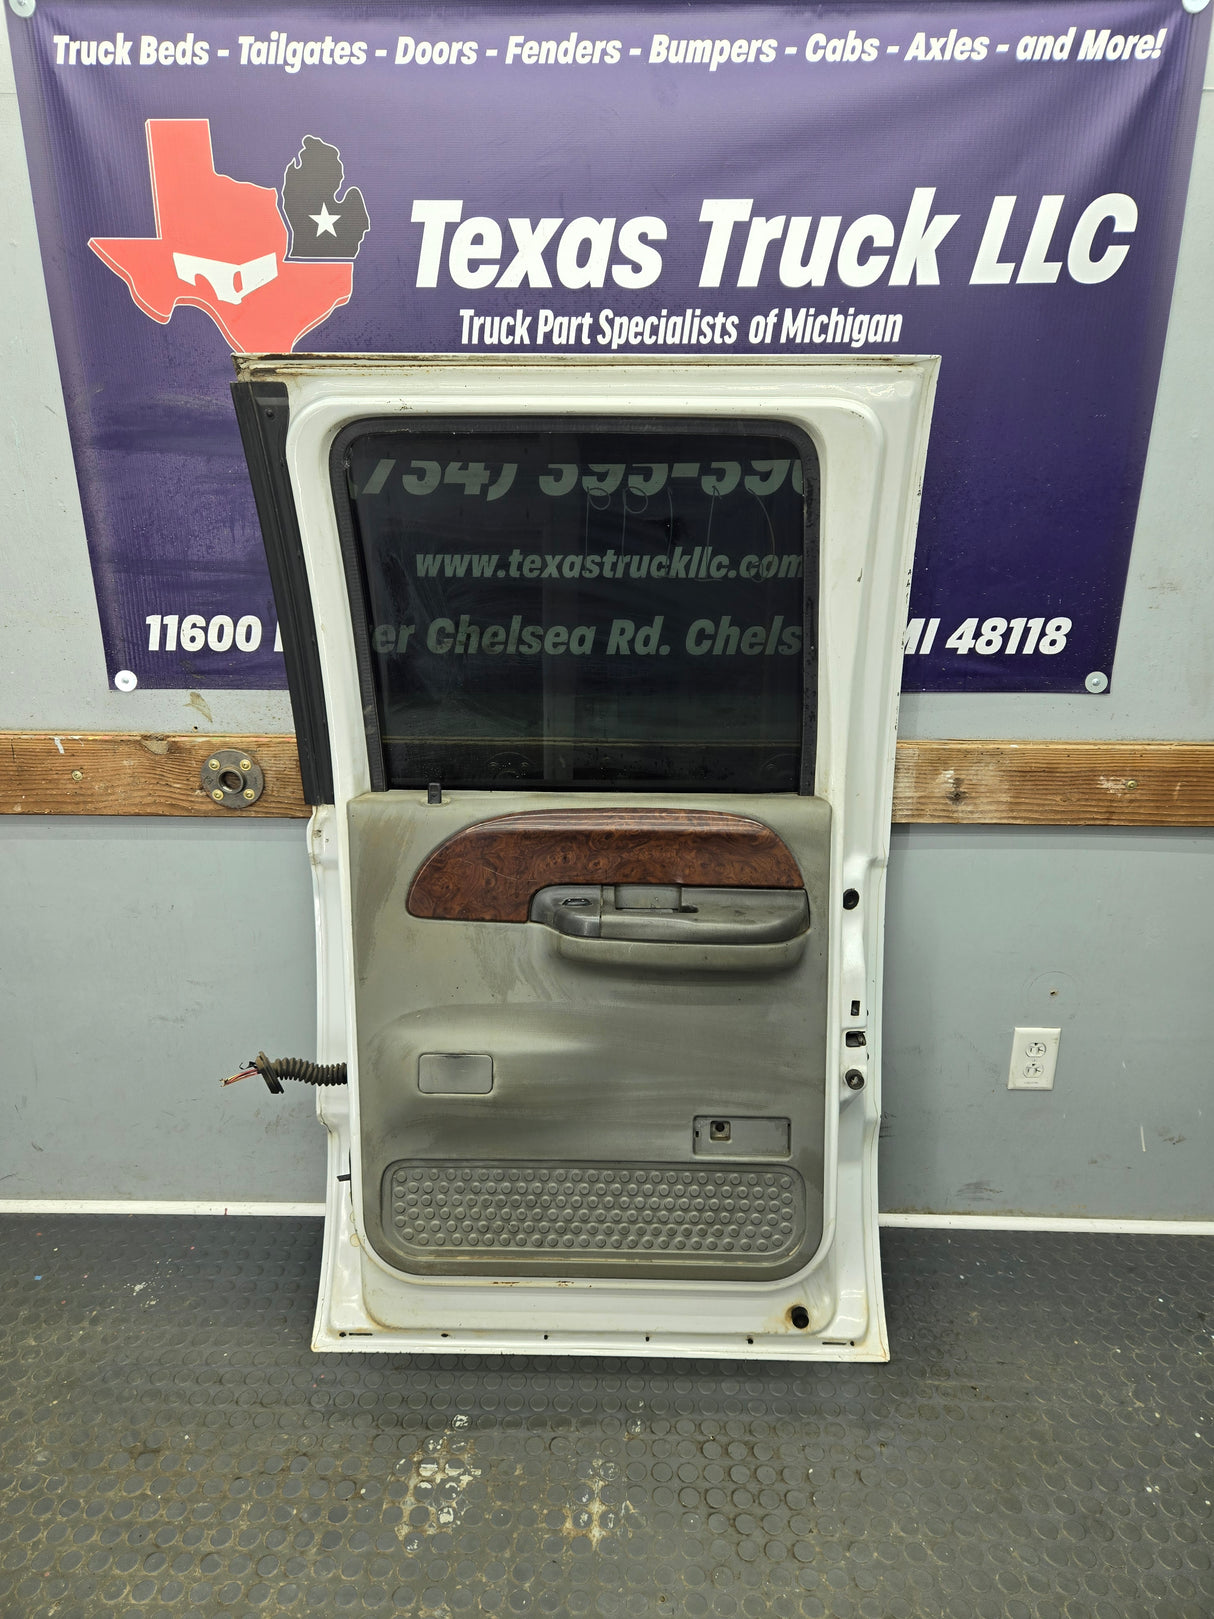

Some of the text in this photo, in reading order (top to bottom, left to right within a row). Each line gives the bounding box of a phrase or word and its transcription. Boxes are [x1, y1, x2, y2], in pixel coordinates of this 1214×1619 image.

[53, 33, 133, 66] Truck
[140, 34, 210, 66] Beds
[238, 32, 369, 74] Tailgates
[395, 36, 479, 66] Doors
[505, 33, 624, 66] Fenders
[648, 34, 779, 72] Bumpers
[805, 31, 881, 63] Cabs
[904, 29, 991, 62] Axles
[1016, 27, 1077, 61] and
[1078, 28, 1168, 61] More!
[410, 187, 1139, 290] Texas Truck LLC
[460, 308, 904, 350] Truck Part Specialists of Michigan
[415, 546, 804, 579] www.texastruckllc.com
[145, 615, 263, 652] 11600
[427, 614, 596, 655] Chelsea
[606, 615, 671, 655] Rd.
[685, 615, 804, 656] Chels
[945, 616, 1073, 655] 48118
